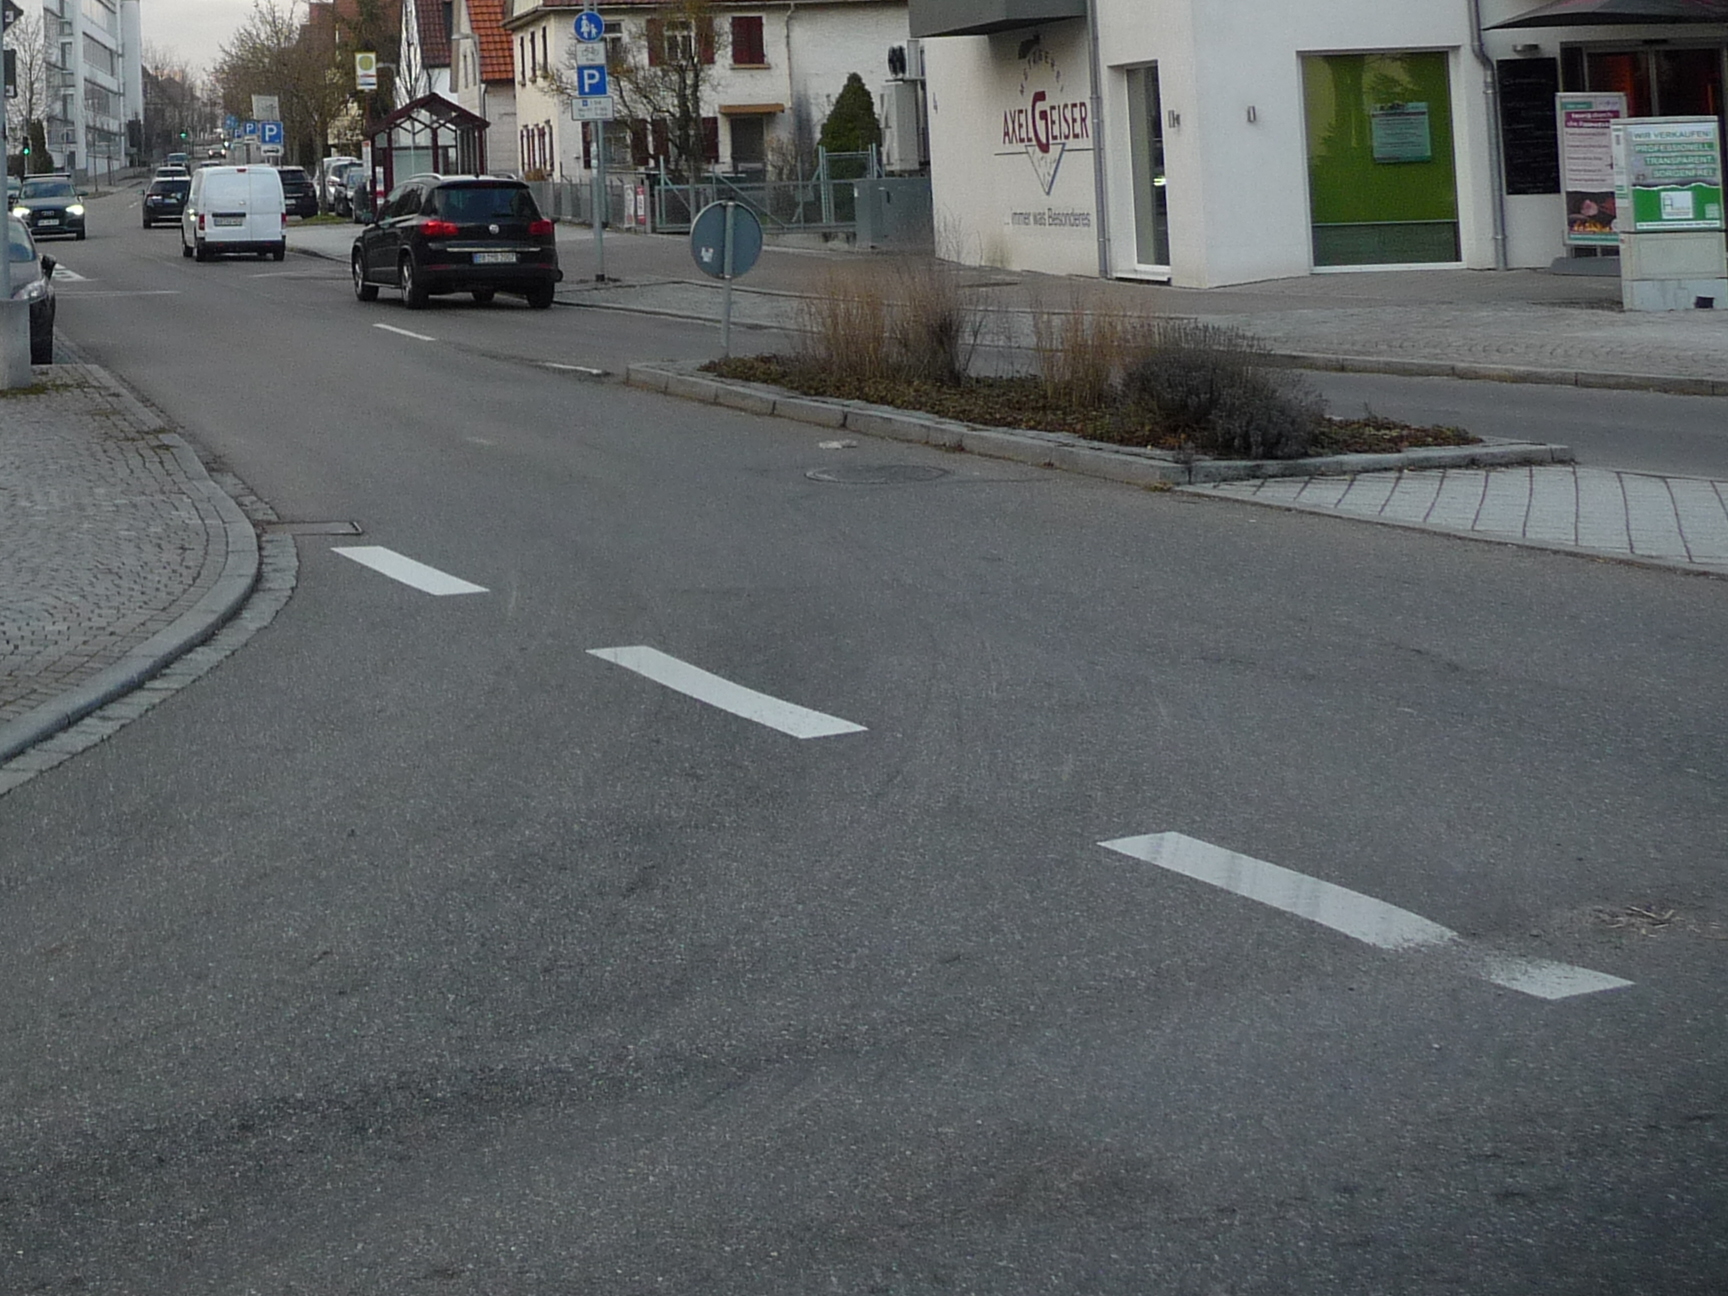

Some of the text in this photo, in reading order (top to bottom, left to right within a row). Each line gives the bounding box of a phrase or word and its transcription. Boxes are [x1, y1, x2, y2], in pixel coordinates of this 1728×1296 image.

[584, 70, 600, 93] P
[265, 124, 277, 142] P
[1634, 131, 1651, 139] WIR
[1047, 207, 1091, 228] Besonderes
